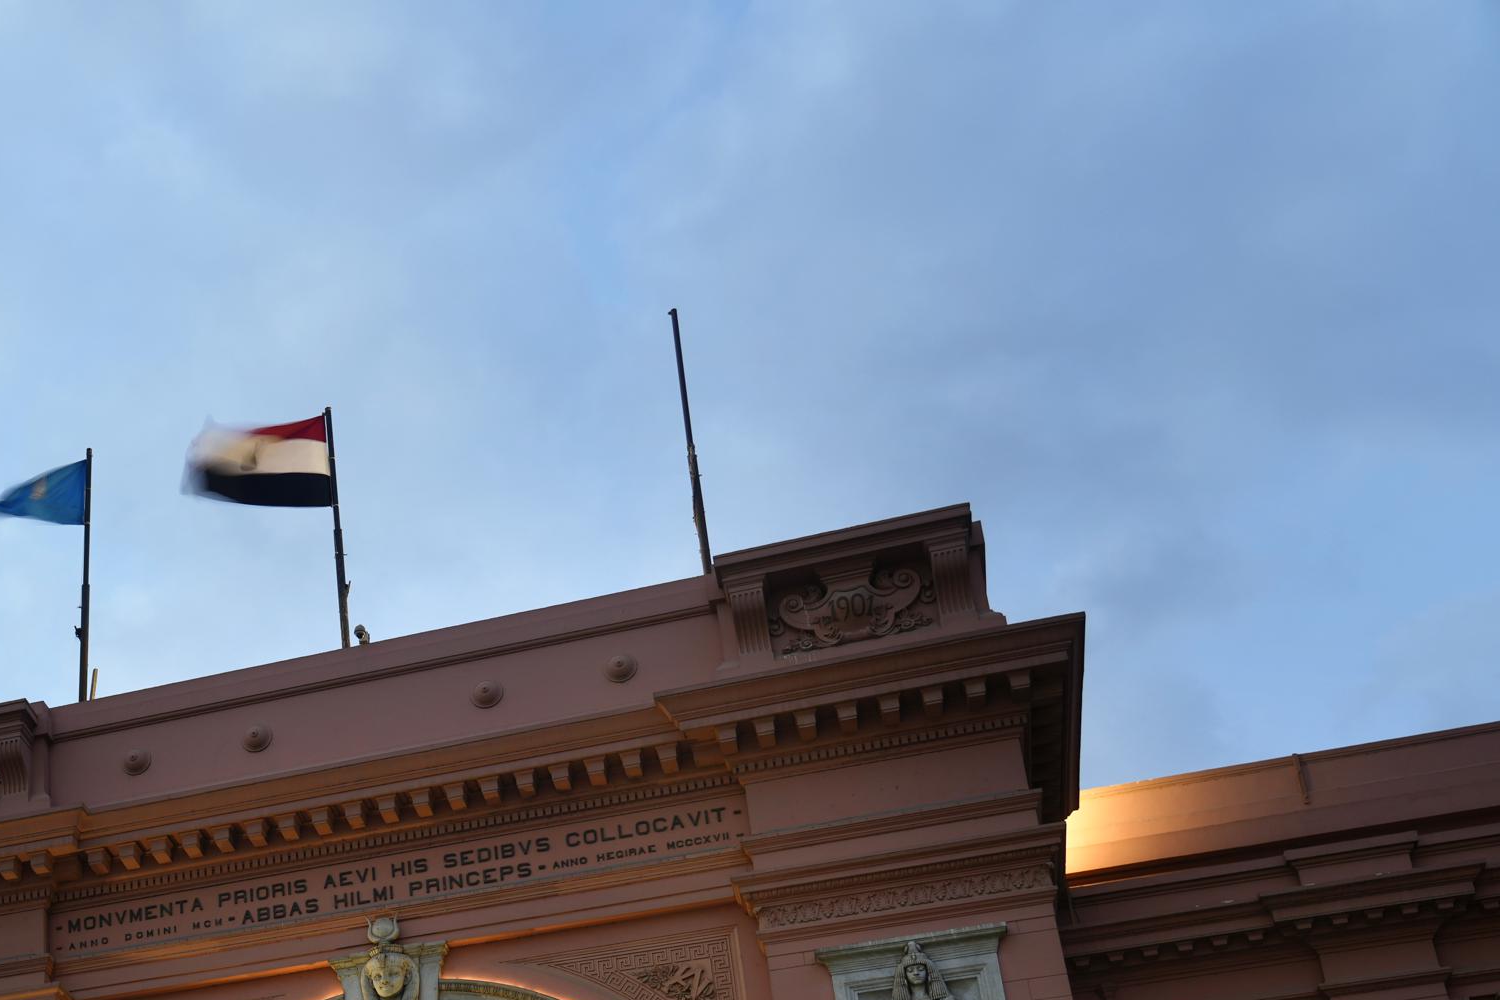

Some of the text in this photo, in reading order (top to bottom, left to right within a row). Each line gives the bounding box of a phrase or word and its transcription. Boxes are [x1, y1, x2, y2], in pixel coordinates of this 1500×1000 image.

[829, 594, 873, 622] 1901
[68, 807, 726, 933] MONVMENTA PRIORIS AEVI HIS SEDIBVS COLLOCAVIT
[68, 937, 109, 950] ANNO
[125, 925, 177, 941] DOMINI
[242, 899, 319, 924] ABBAS
[334, 885, 394, 909] HILMI
[408, 862, 532, 897] PRINCEPS
[552, 856, 589, 870] ANNO
[596, 845, 657, 862] HEGIRAE
[666, 832, 730, 850] MCCCXVII
